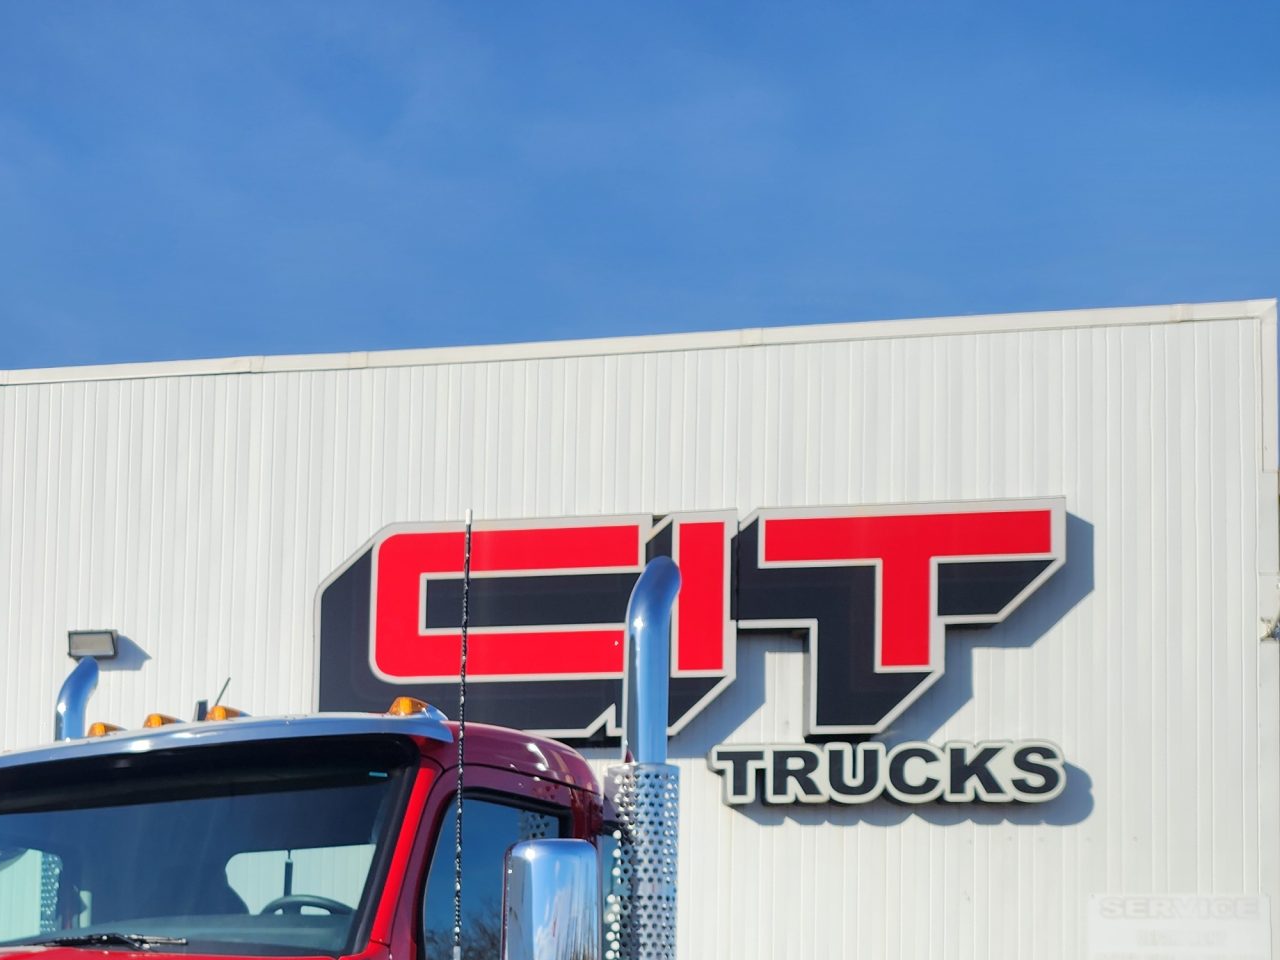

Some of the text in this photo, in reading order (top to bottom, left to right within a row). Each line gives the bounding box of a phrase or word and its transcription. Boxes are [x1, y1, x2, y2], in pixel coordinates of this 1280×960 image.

[328, 498, 1065, 730] CIT
[714, 742, 1064, 801] TRUCKS
[1099, 896, 1261, 919] SERVICE
